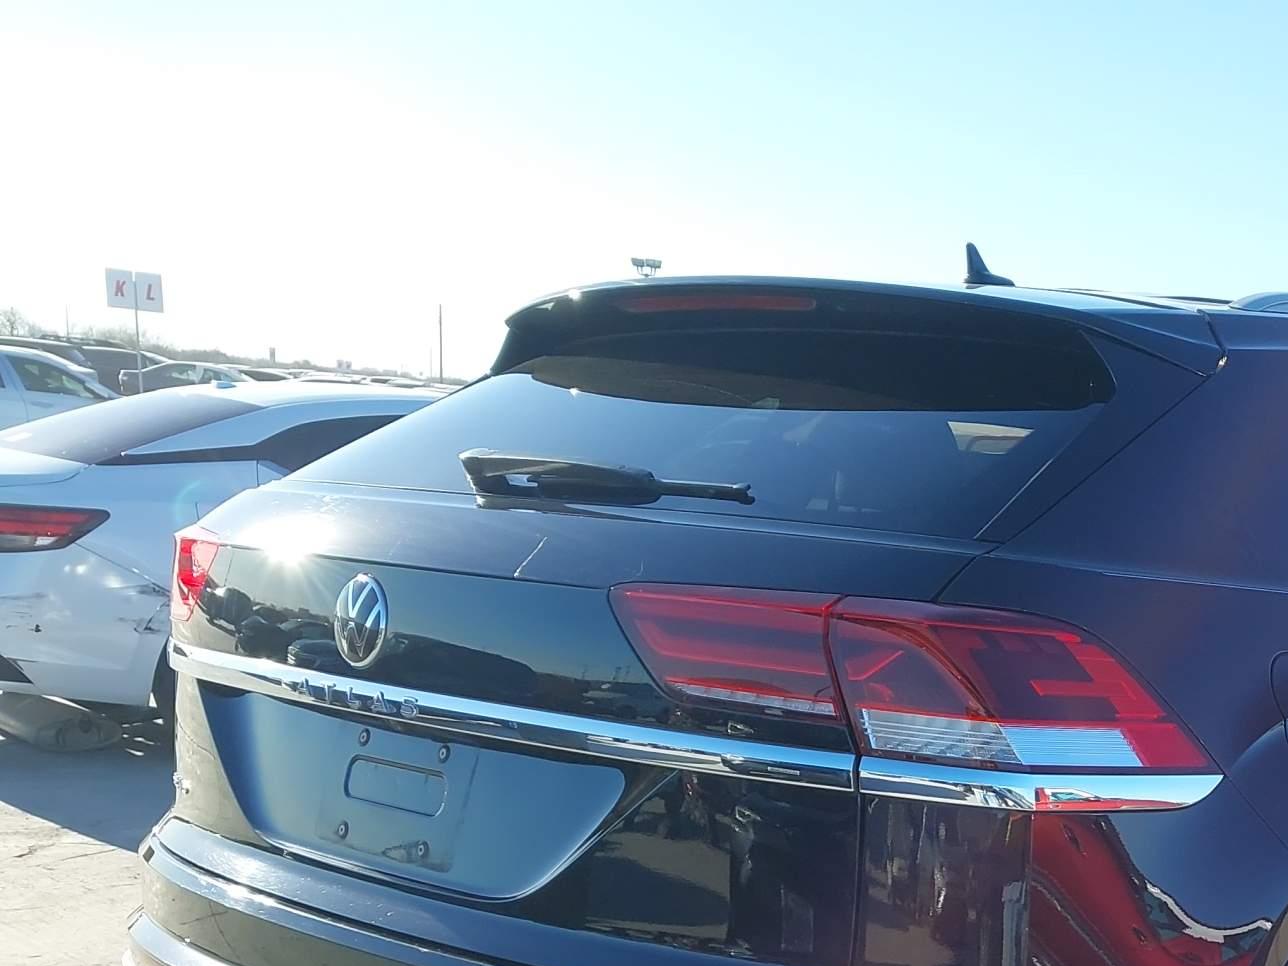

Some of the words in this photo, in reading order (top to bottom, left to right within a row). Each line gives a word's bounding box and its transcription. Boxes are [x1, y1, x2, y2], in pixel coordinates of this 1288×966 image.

[114, 279, 126, 297] K
[145, 283, 156, 301] L
[297, 677, 418, 718] ATLAS
